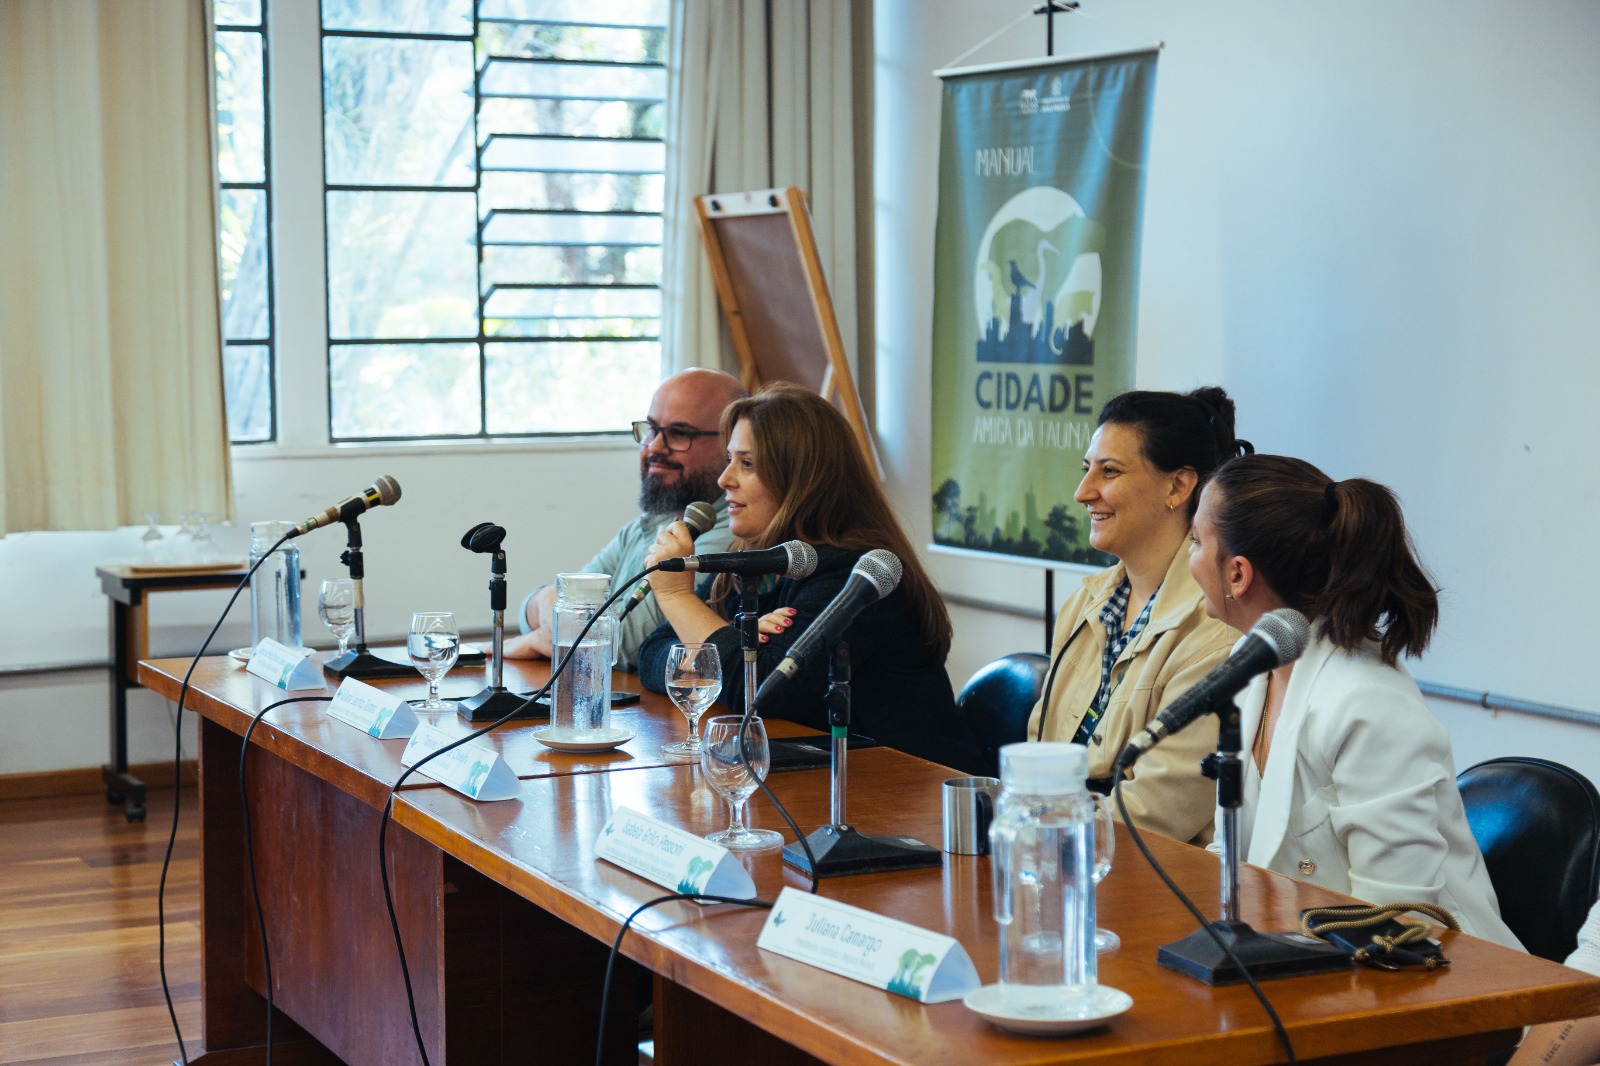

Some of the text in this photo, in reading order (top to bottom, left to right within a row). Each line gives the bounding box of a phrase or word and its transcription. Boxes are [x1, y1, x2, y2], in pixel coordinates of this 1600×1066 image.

[975, 146, 1034, 177] MANUAL
[975, 370, 1094, 414] CIDADE
[973, 416, 1091, 450] AMIGA DA FAUNA
[806, 913, 882, 956] Juliana Camargo
